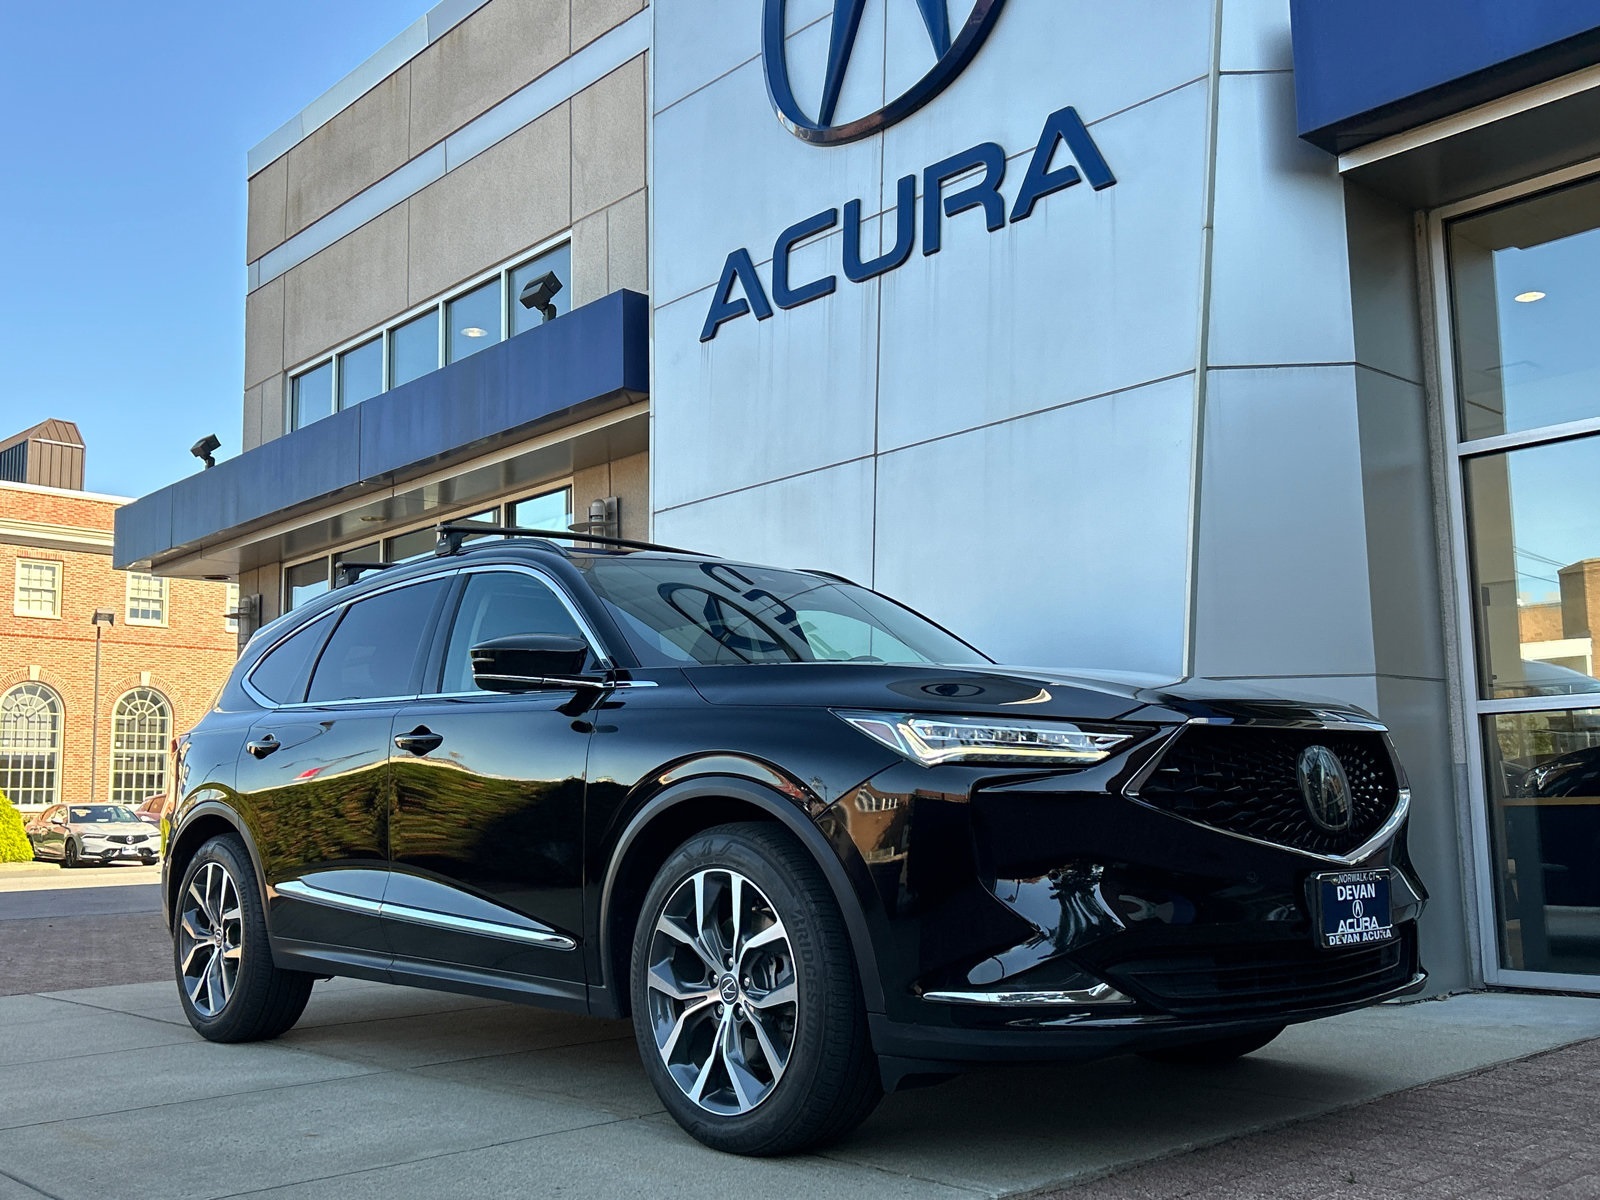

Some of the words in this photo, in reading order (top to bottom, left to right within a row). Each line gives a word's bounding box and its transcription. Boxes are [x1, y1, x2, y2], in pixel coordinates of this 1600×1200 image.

[700, 105, 1117, 343] ACURA
[1337, 883, 1375, 901] DEVAN
[1337, 916, 1378, 933] ACURA
[1329, 933, 1360, 945] DEVAN
[1362, 929, 1392, 942] ACURA
